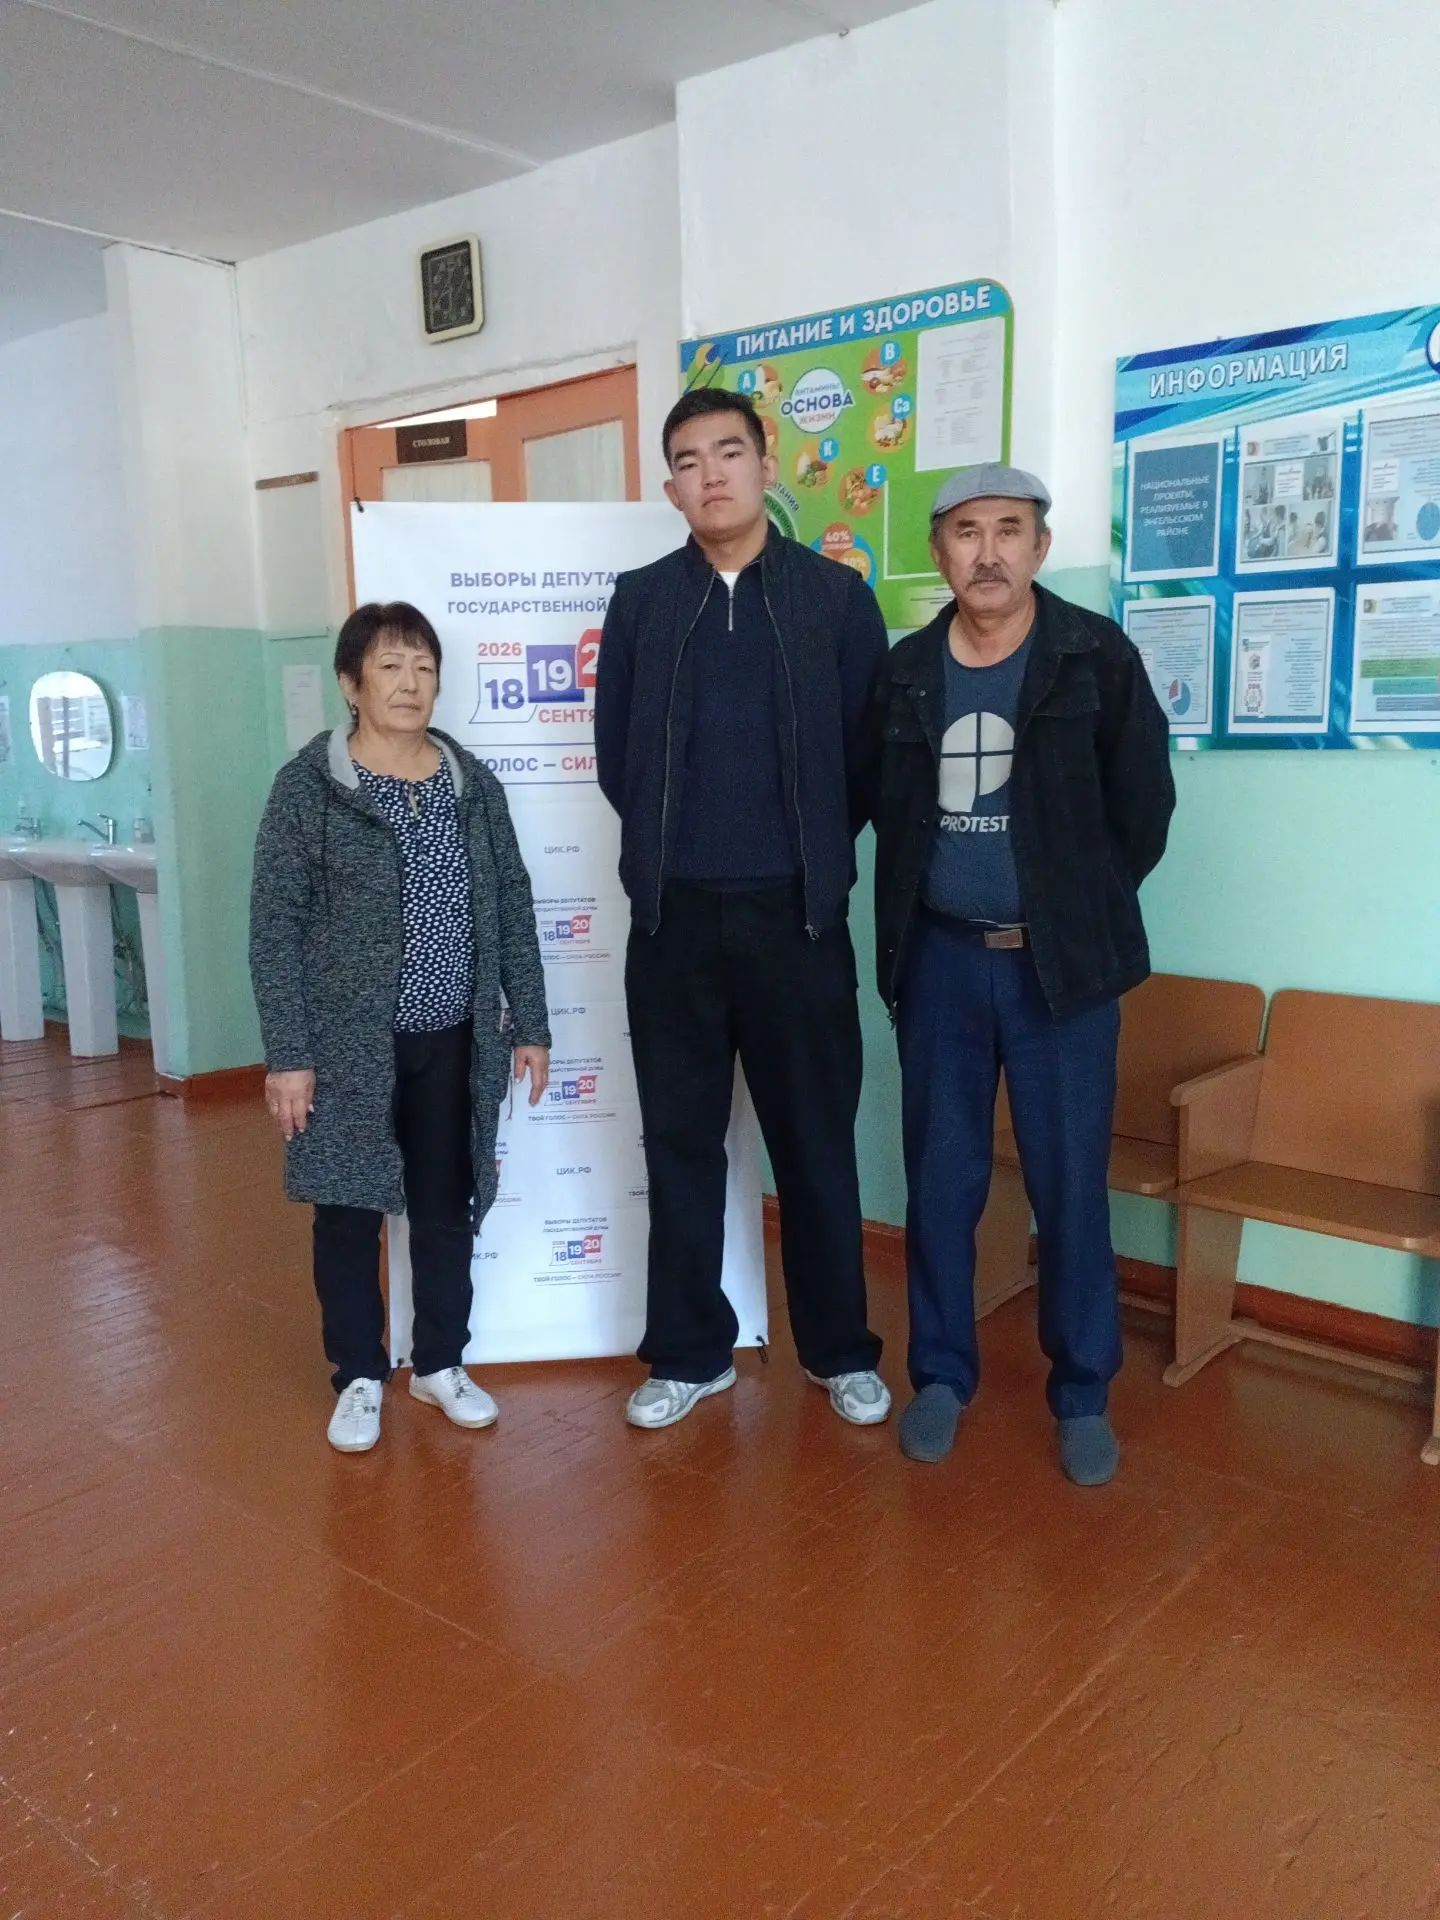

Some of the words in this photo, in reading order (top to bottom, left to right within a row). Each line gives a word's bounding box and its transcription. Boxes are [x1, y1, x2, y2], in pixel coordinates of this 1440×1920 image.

[736, 319, 833, 357] ПИТАНИЕ
[839, 318, 855, 336] И
[862, 285, 991, 334] ЗДОРОВЬЕ
[1149, 342, 1349, 398] ИНФОРМАЦИЯ
[781, 392, 854, 415] ОСНОВА
[450, 573, 536, 587] ВЫБОРЫ
[448, 597, 607, 615] ГОСУДАРСТВЕННОЙ
[478, 643, 522, 656] 2026
[485, 679, 524, 710] 18
[532, 659, 573, 692] 19
[940, 816, 1010, 832] PROTEST
[543, 931, 556, 941] 18
[557, 925, 570, 936] 19
[573, 919, 589, 930] 20
[548, 1092, 562, 1102] 18
[563, 1085, 577, 1096] 19
[578, 1080, 594, 1090] 20
[556, 1167, 592, 1175] ЦИК.РФ
[554, 1252, 567, 1262] 18
[569, 1245, 582, 1256] 19
[583, 1239, 600, 1250] 20
